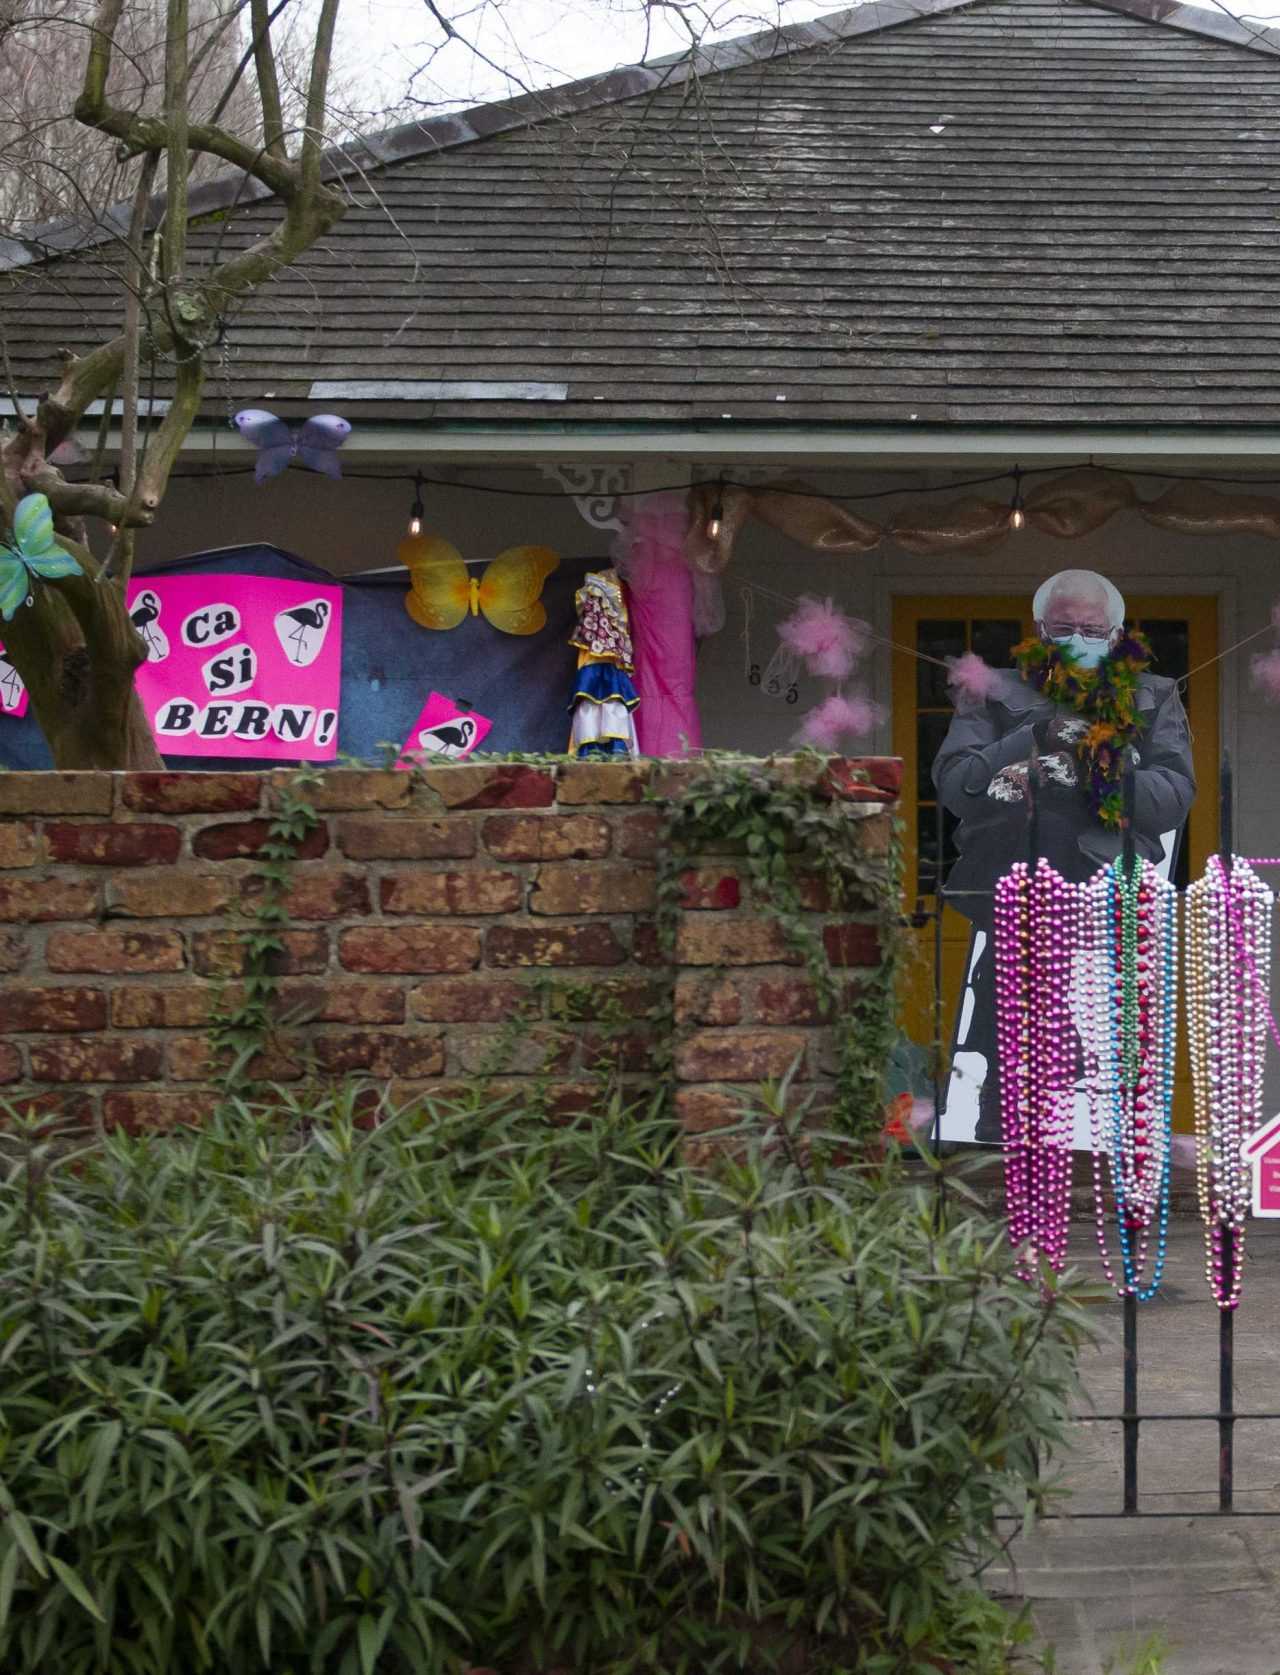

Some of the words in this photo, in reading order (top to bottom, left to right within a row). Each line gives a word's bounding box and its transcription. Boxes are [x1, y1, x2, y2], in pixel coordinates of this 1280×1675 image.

[186, 610, 237, 644] Ca
[209, 647, 253, 692] Si
[162, 704, 336, 744] BERN!
